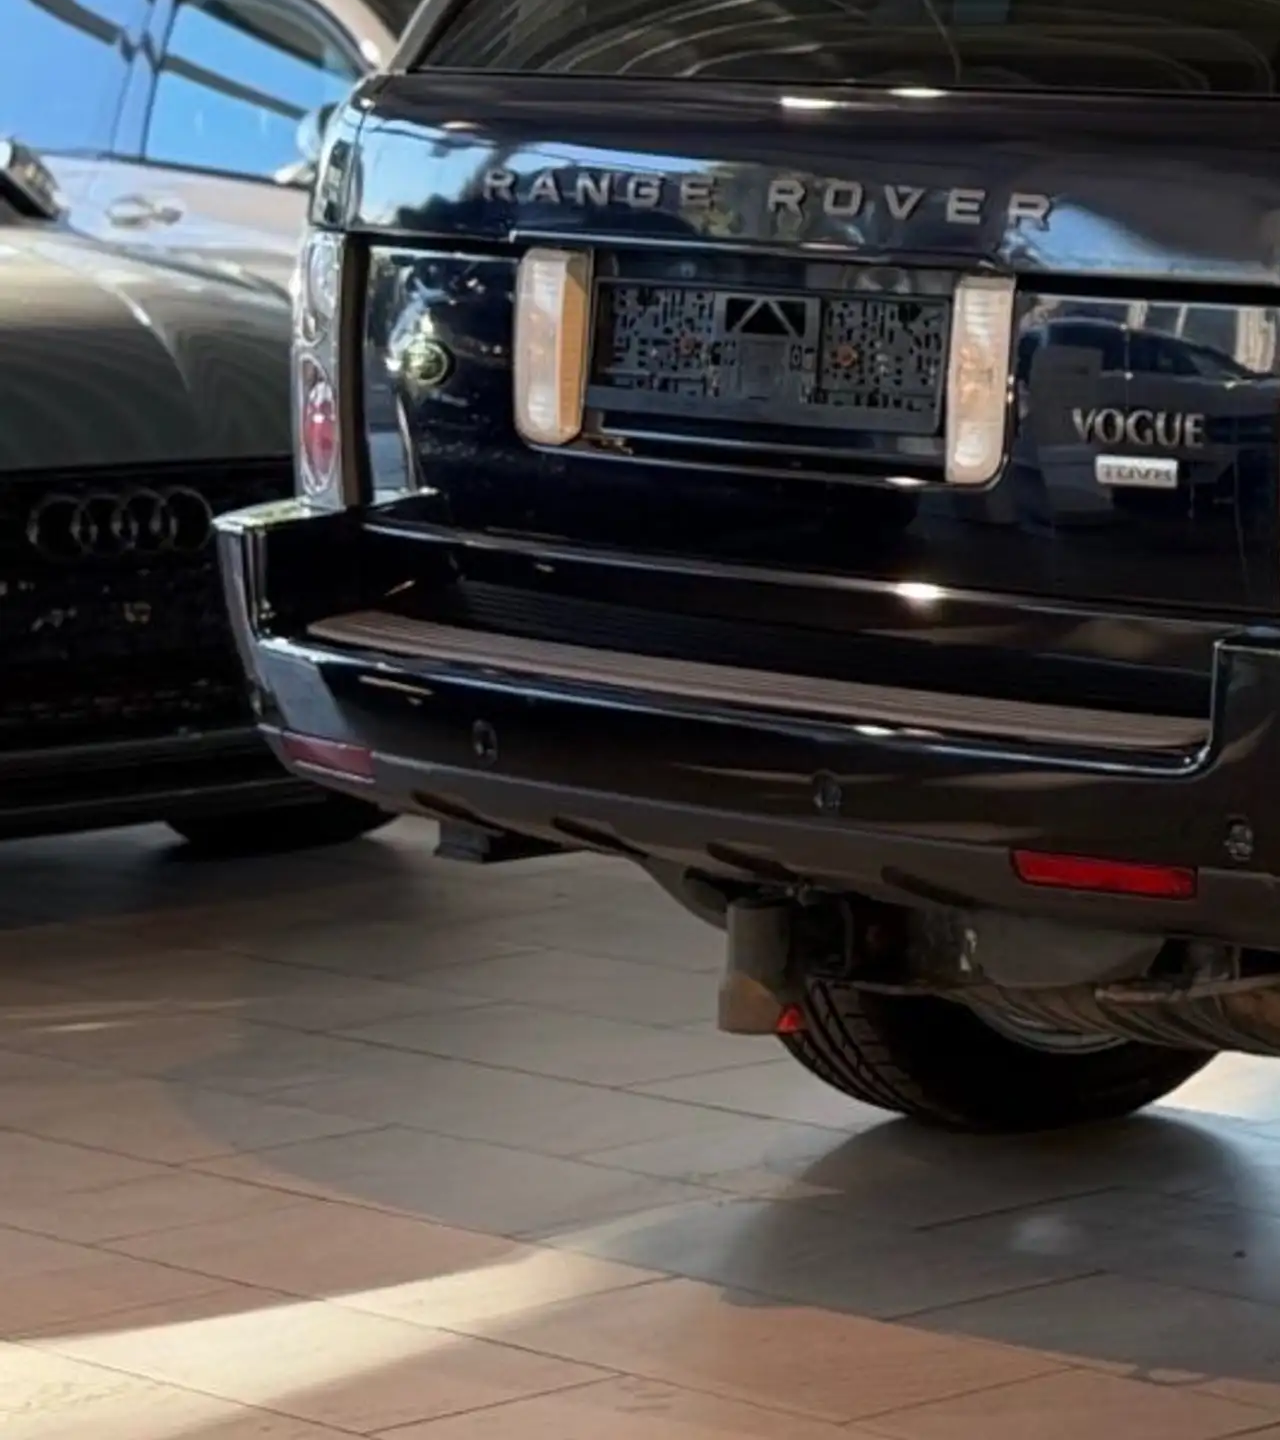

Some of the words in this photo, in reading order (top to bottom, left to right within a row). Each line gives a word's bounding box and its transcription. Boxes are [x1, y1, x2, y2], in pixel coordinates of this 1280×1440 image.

[482, 166, 716, 209] RANGE
[766, 179, 1052, 229] ROVER
[1072, 407, 1205, 449] VOGUE
